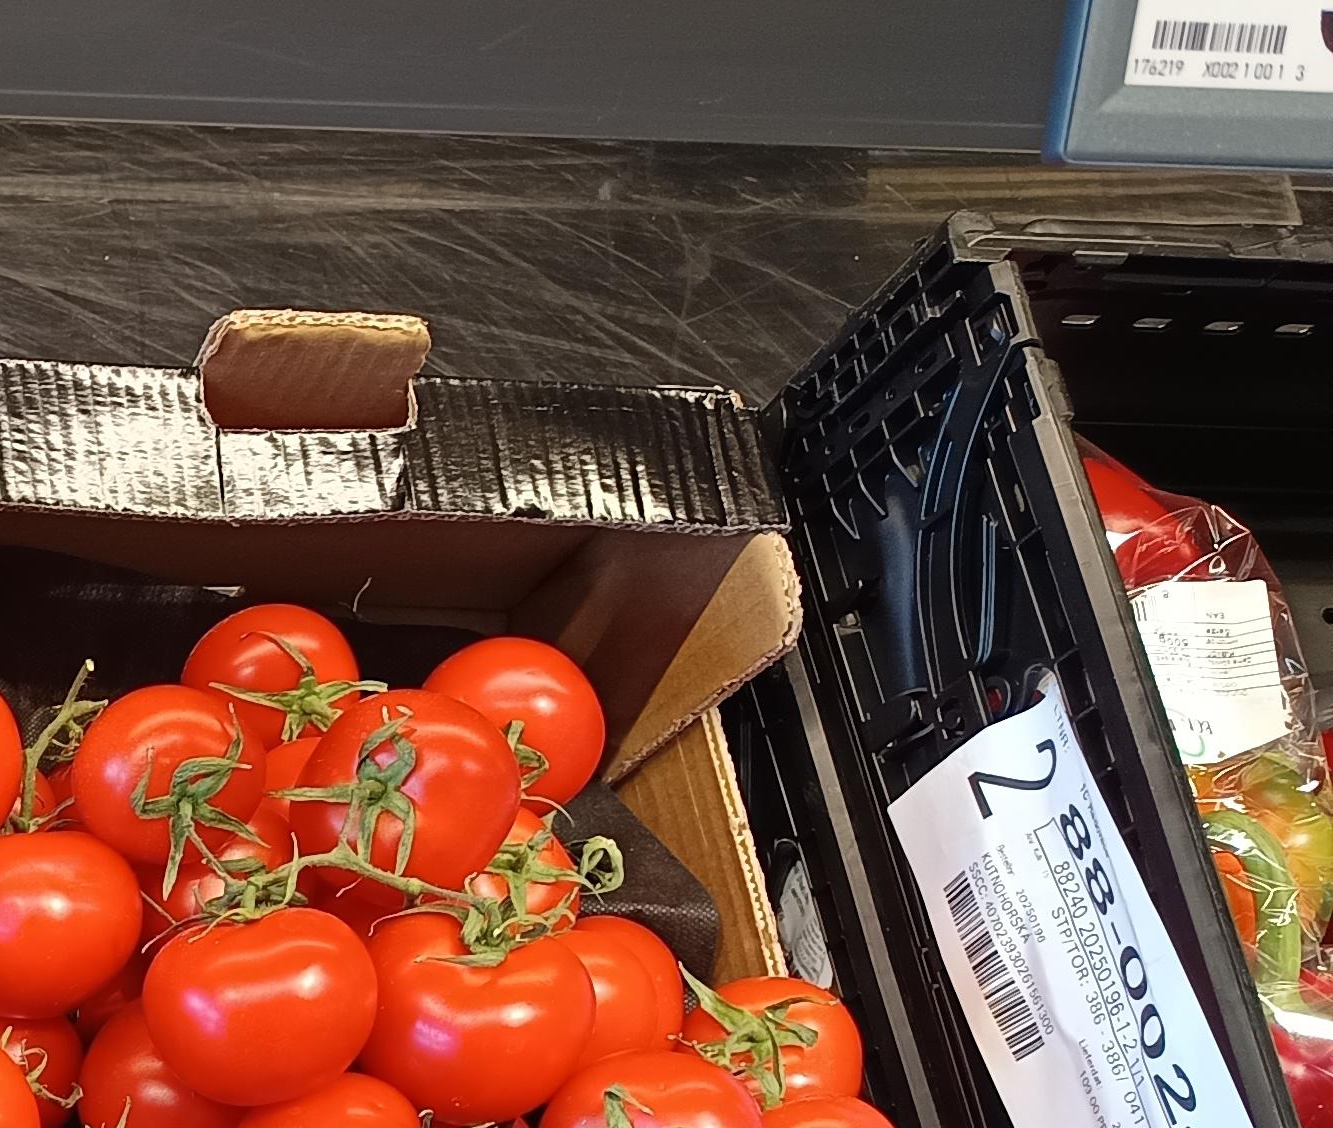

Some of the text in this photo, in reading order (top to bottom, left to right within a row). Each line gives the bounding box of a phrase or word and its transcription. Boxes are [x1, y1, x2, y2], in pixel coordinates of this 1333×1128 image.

[1133, 58, 1184, 76] 176219
[1294, 64, 1305, 82] 3
[968, 739, 1056, 819] 2
[969, 862, 988, 899] SSCC:
[986, 902, 1054, 1035] 407023930261561300
[1054, 861, 1088, 918] 88240
[1079, 922, 1137, 1054] 20250196-1-2
[1052, 907, 1089, 986] STP/TOR:
[1086, 991, 1105, 1025] 386
[1102, 1040, 1129, 1081] 386/
[1124, 1092, 1149, 1124] 041
[1090, 1096, 1099, 1114] 00
